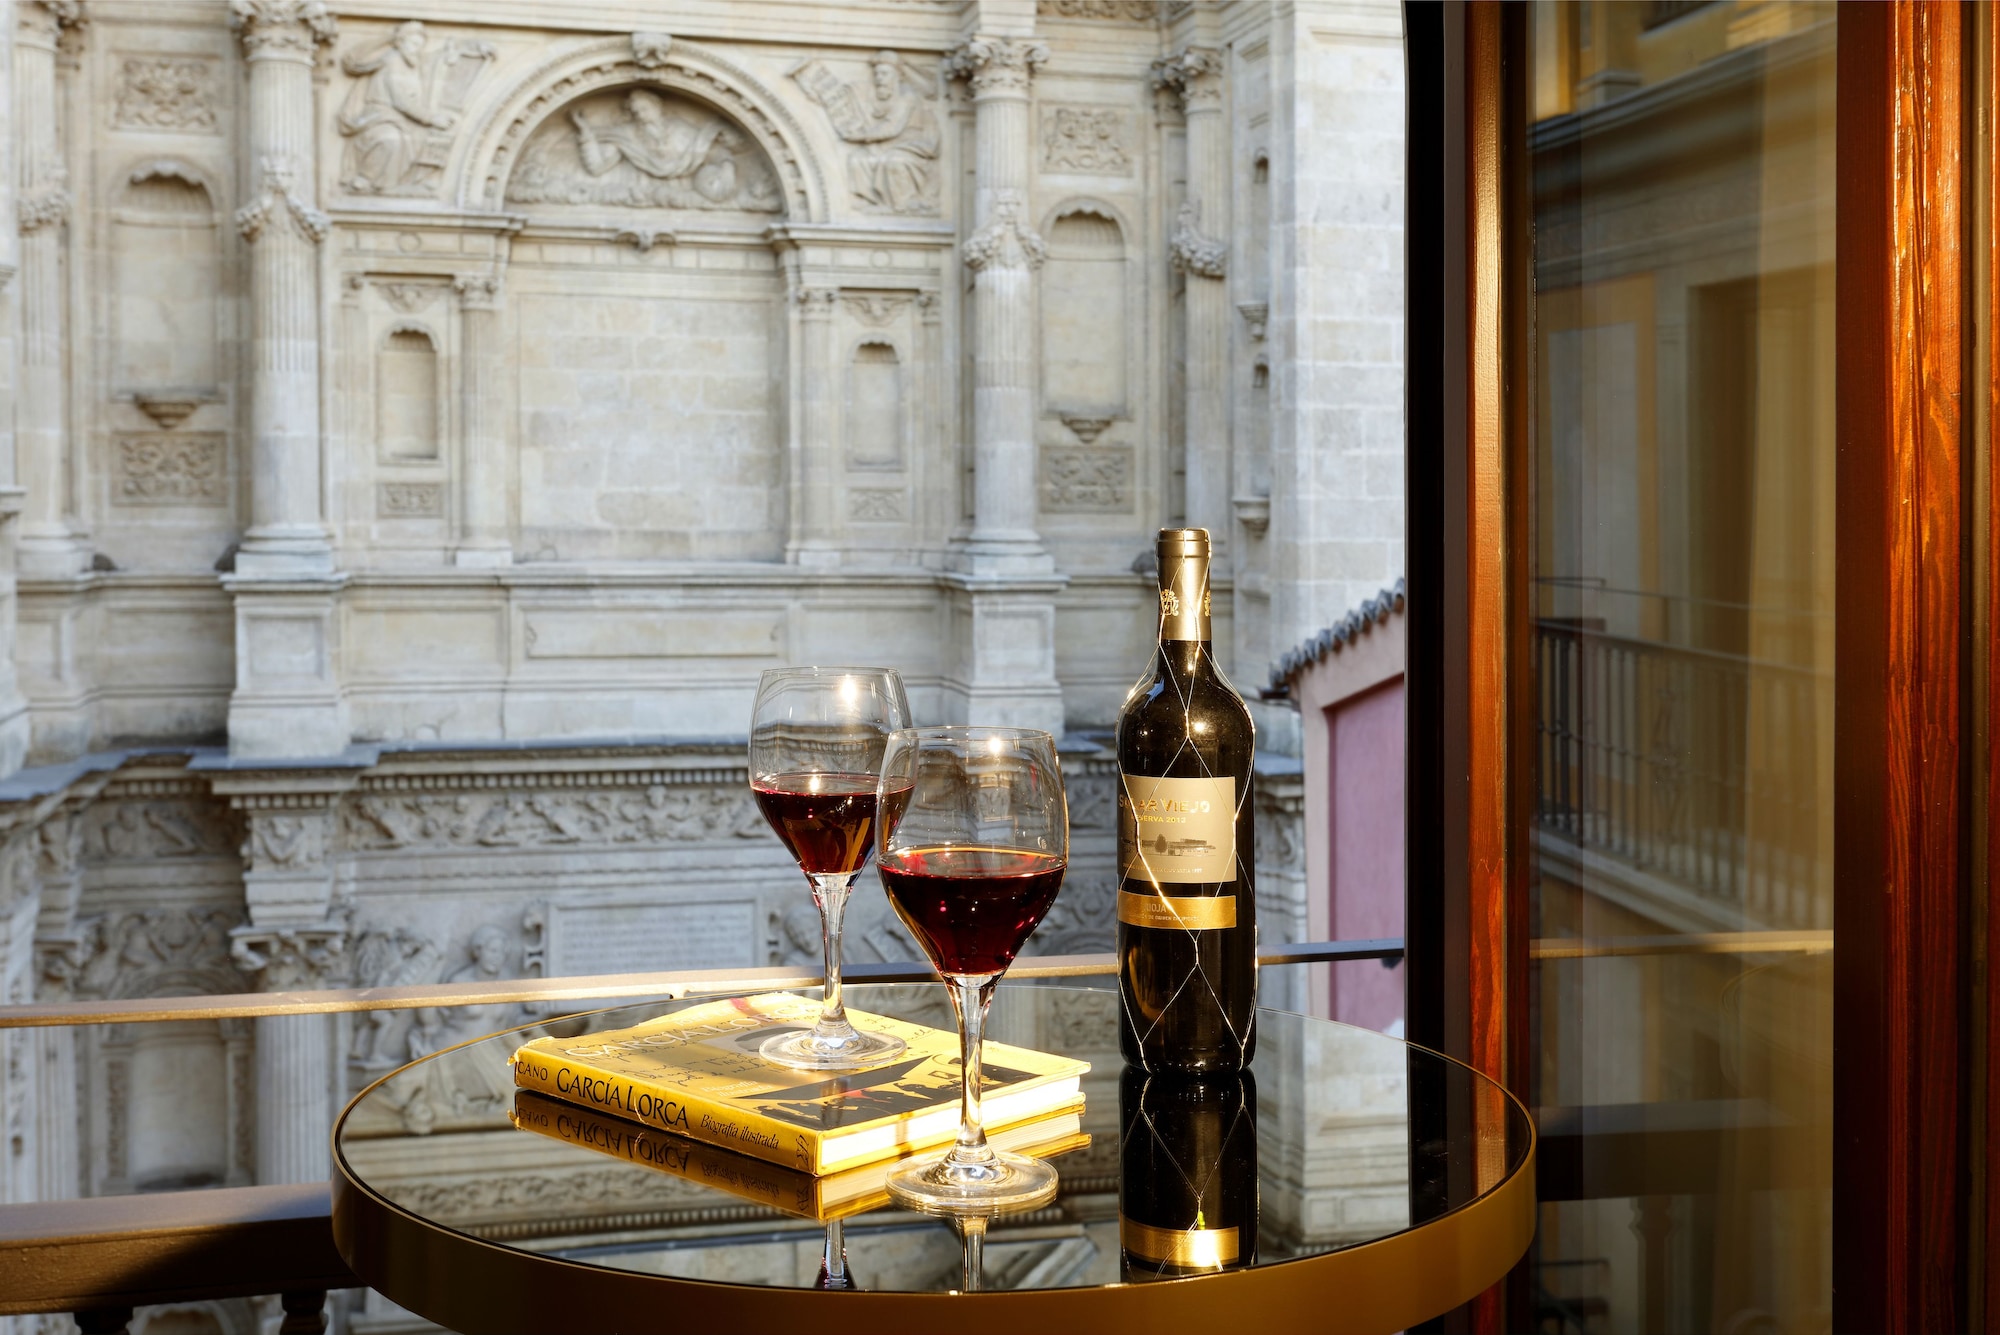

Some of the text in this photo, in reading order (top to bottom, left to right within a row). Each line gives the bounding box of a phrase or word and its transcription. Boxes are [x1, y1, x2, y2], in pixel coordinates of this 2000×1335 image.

[1160, 797, 1210, 814] VIEJO
[518, 1060, 548, 1081] CANO
[556, 1067, 623, 1109] GARCÍA
[627, 1085, 690, 1130] LORCA
[701, 1114, 739, 1139] Biografía
[740, 1126, 780, 1150] ilustrada
